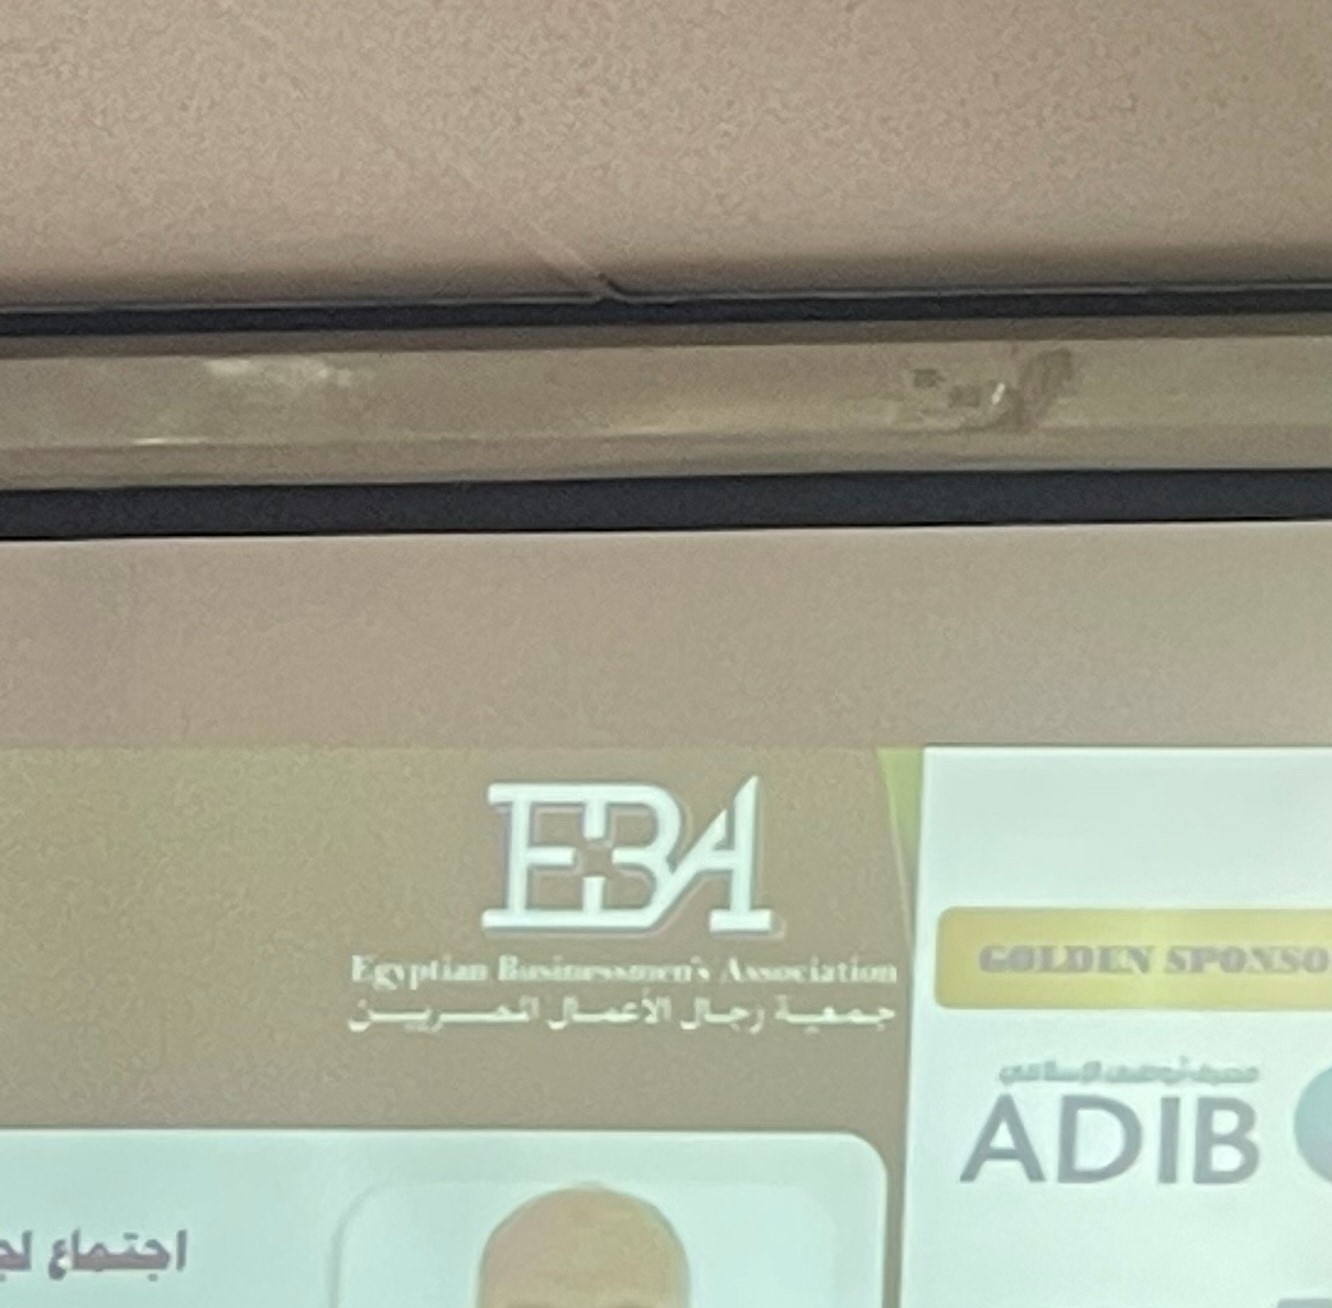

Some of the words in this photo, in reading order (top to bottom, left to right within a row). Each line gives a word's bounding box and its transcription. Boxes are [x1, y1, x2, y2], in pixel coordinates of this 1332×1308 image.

[481, 774, 773, 934] EBA
[351, 955, 487, 990] Egyptian
[720, 955, 897, 984] Association
[978, 944, 1153, 974] GOLDEN
[959, 1094, 1260, 1184] ADIB
[48, 1228, 188, 1282] اجتماع
